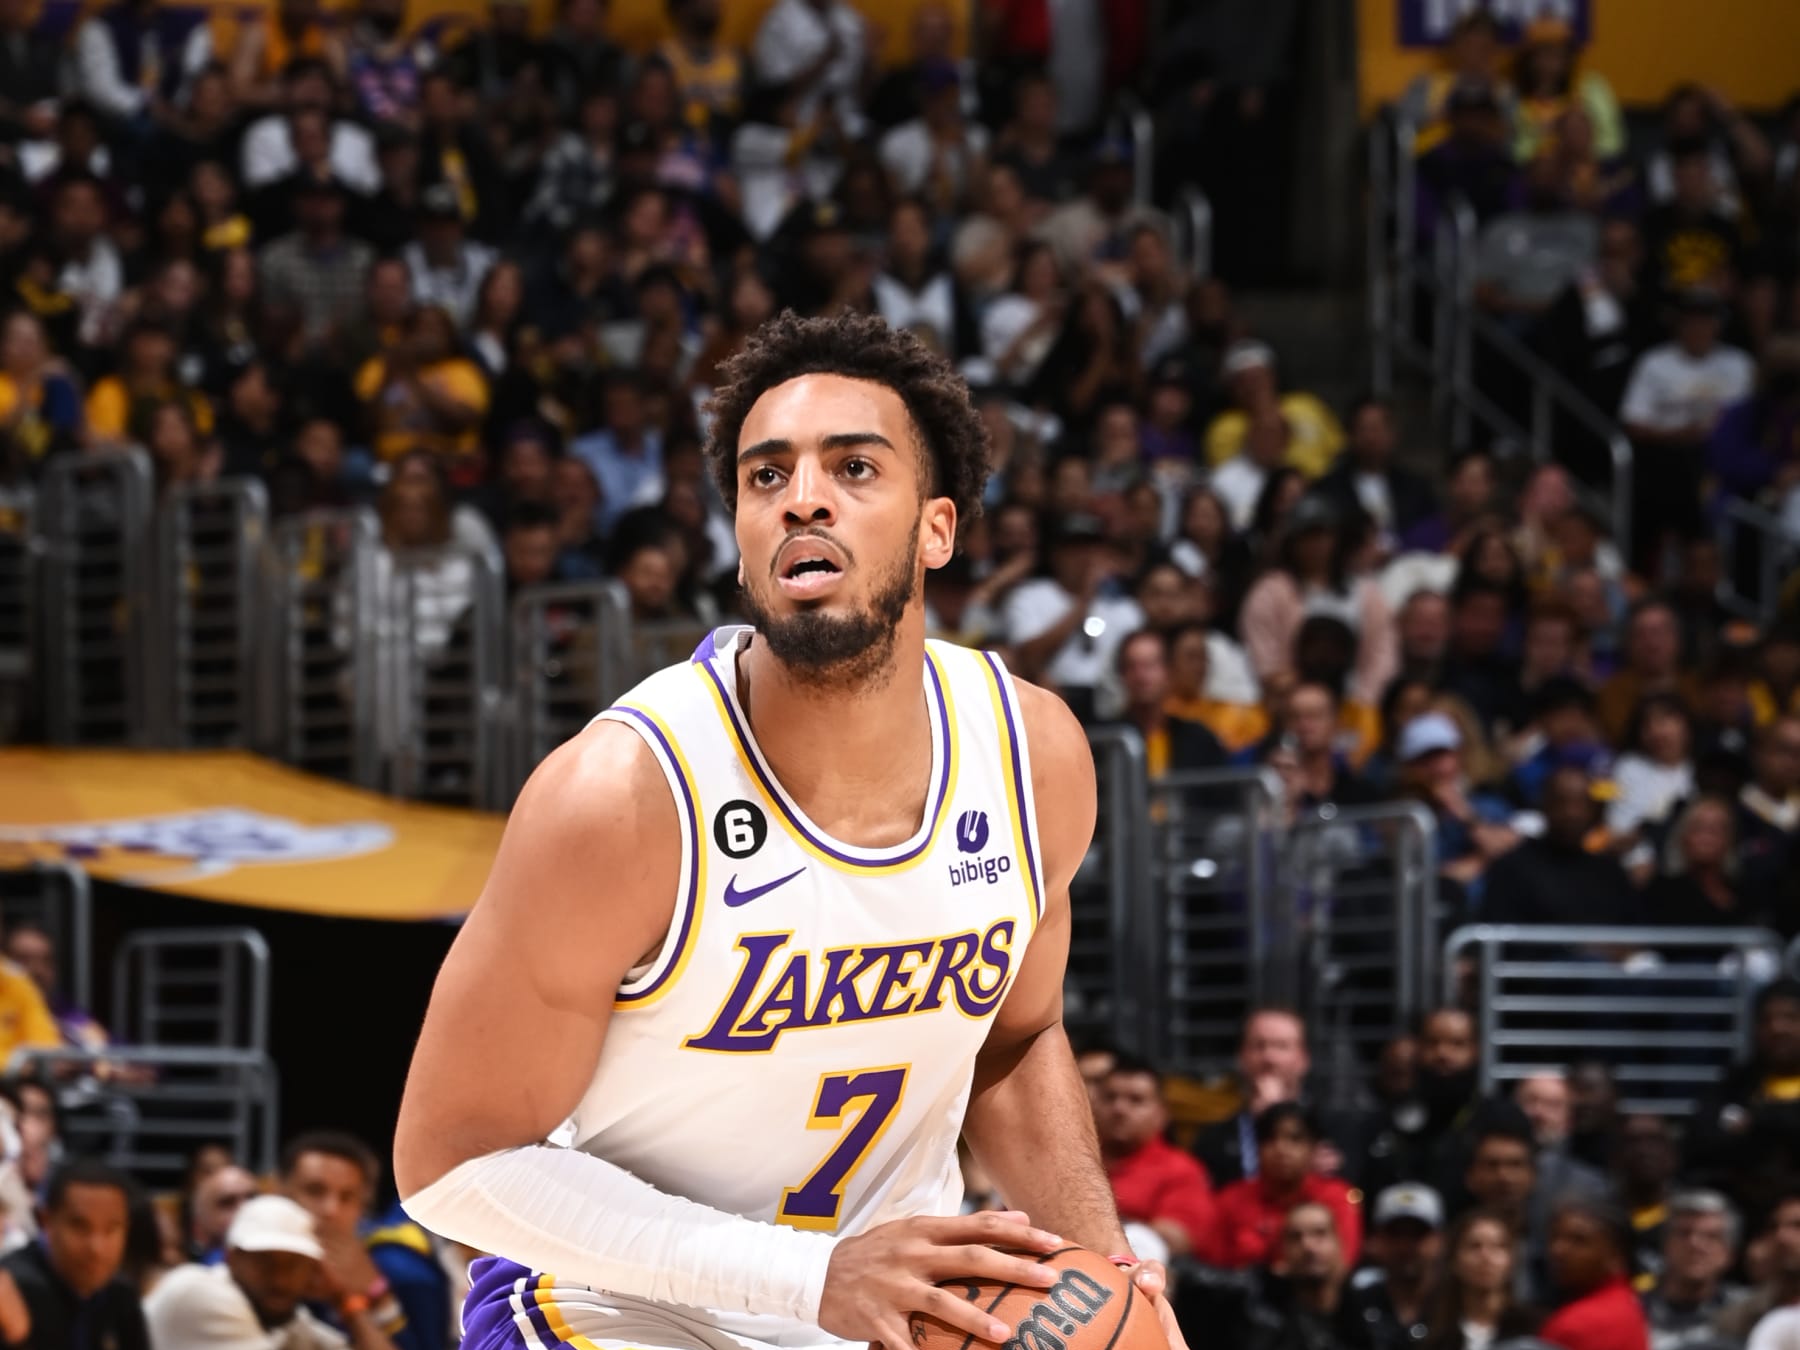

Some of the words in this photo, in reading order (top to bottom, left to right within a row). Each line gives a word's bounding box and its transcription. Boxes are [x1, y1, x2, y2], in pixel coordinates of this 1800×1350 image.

[724, 808, 755, 852] 6
[948, 856, 1010, 887] bibigo
[680, 918, 1017, 1053] LAKERS
[775, 1063, 911, 1232] 7
